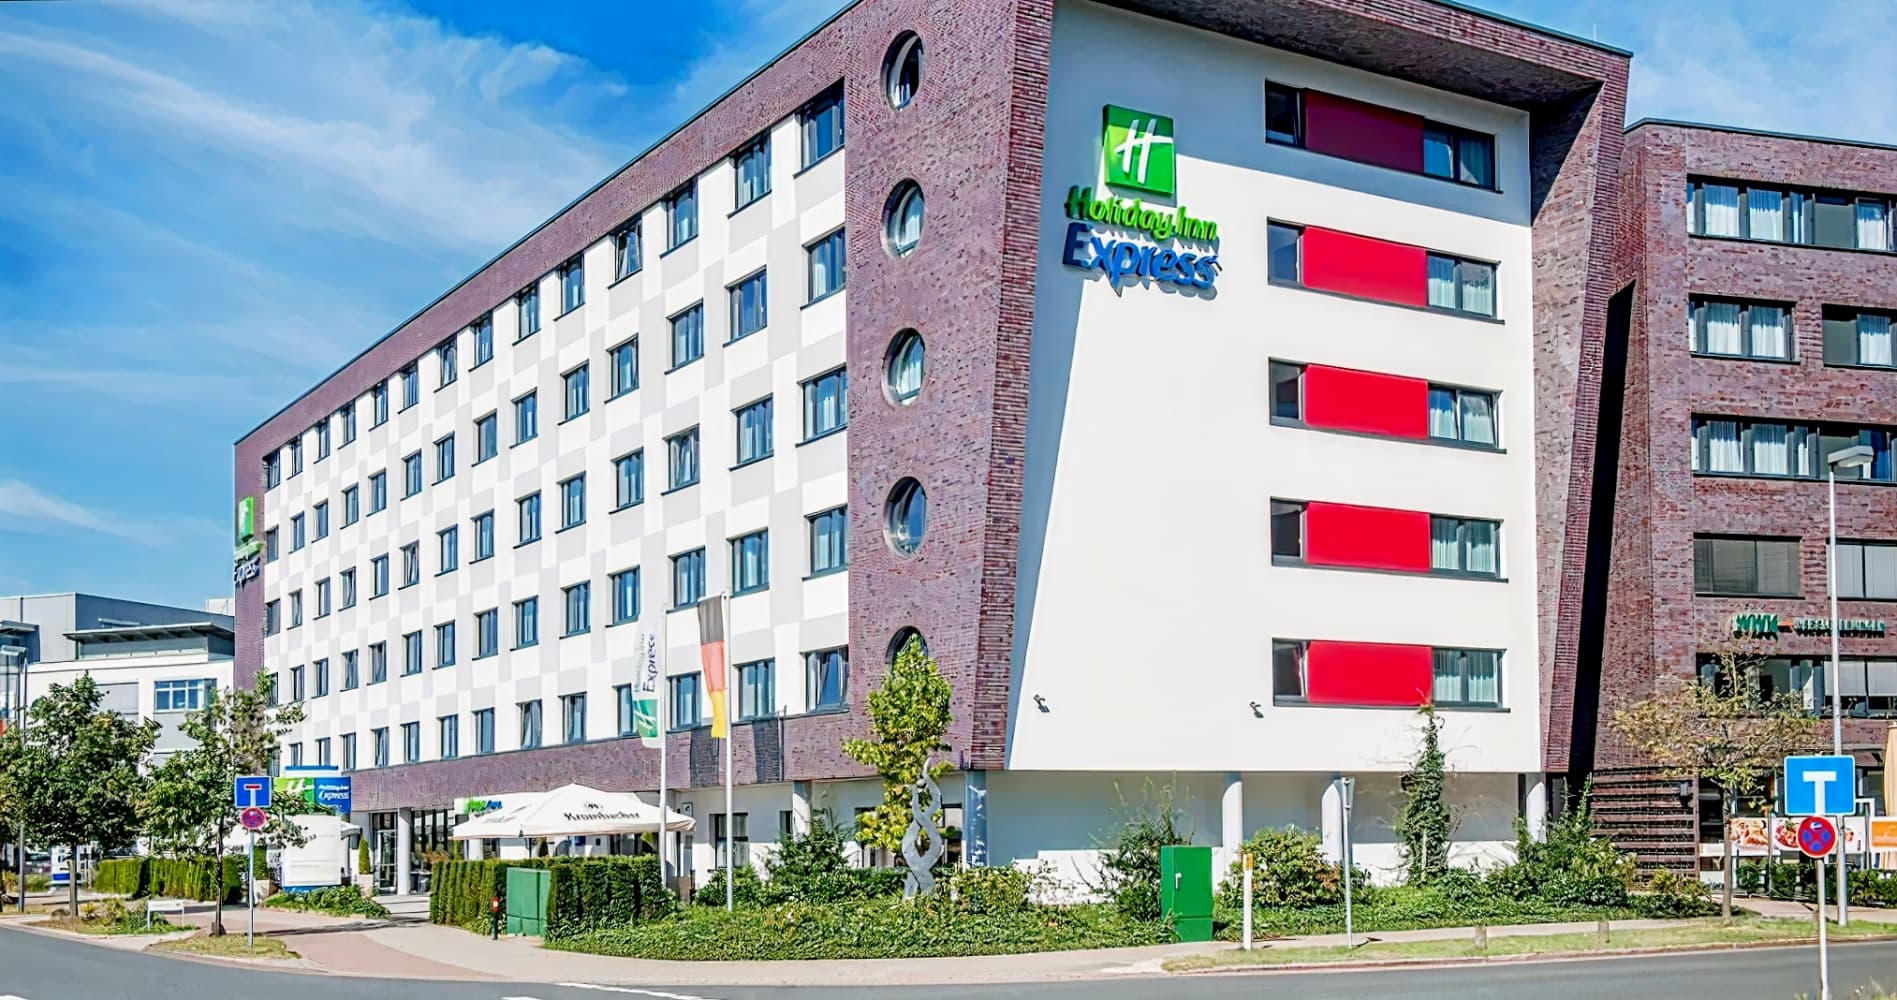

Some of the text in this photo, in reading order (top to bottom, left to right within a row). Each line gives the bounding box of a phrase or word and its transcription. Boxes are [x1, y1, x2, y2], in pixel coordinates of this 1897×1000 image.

[1065, 184, 1217, 241] Holiday Inn
[1063, 222, 1219, 290] Express
